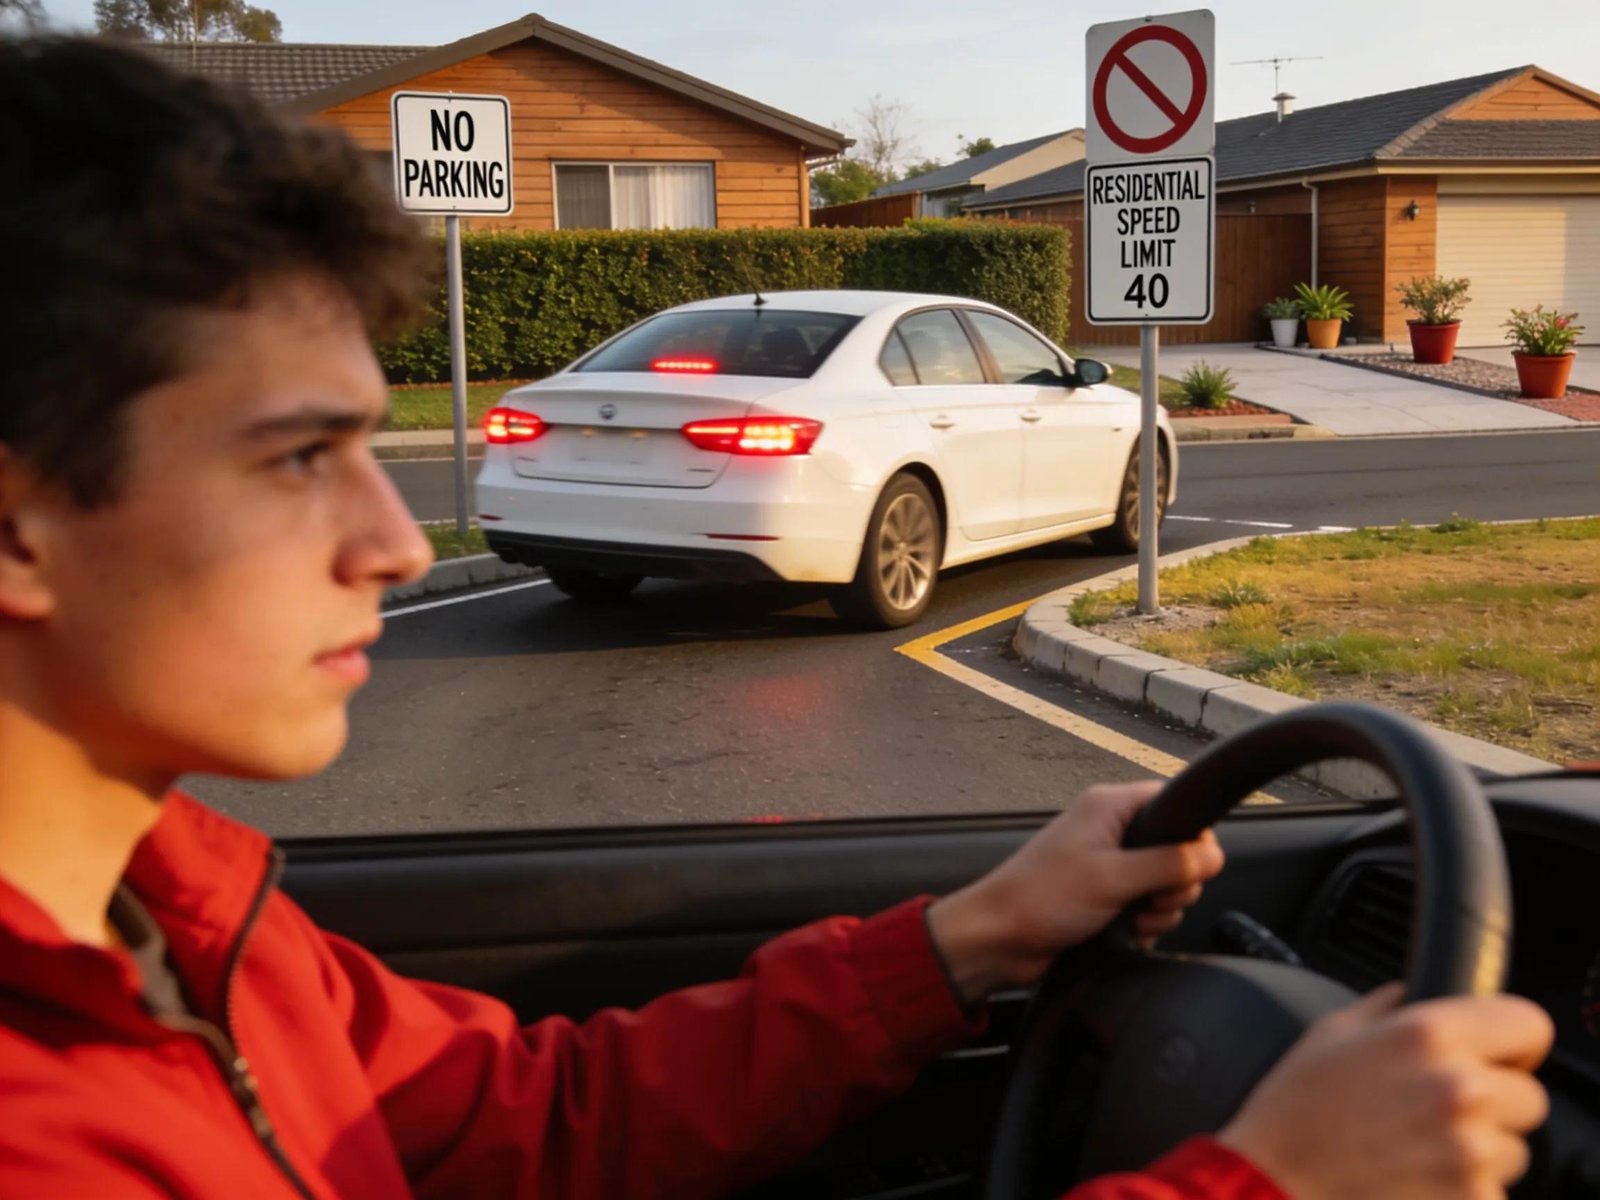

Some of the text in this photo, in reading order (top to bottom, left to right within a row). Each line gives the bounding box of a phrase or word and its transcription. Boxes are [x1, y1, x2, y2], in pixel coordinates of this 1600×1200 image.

[430, 109, 475, 152] NO
[403, 159, 504, 199] PARKING
[1093, 170, 1206, 205] RESIDENTIAL
[1117, 206, 1180, 236] SPEED
[1121, 239, 1176, 268] LIMIT
[1123, 273, 1169, 309] 40
